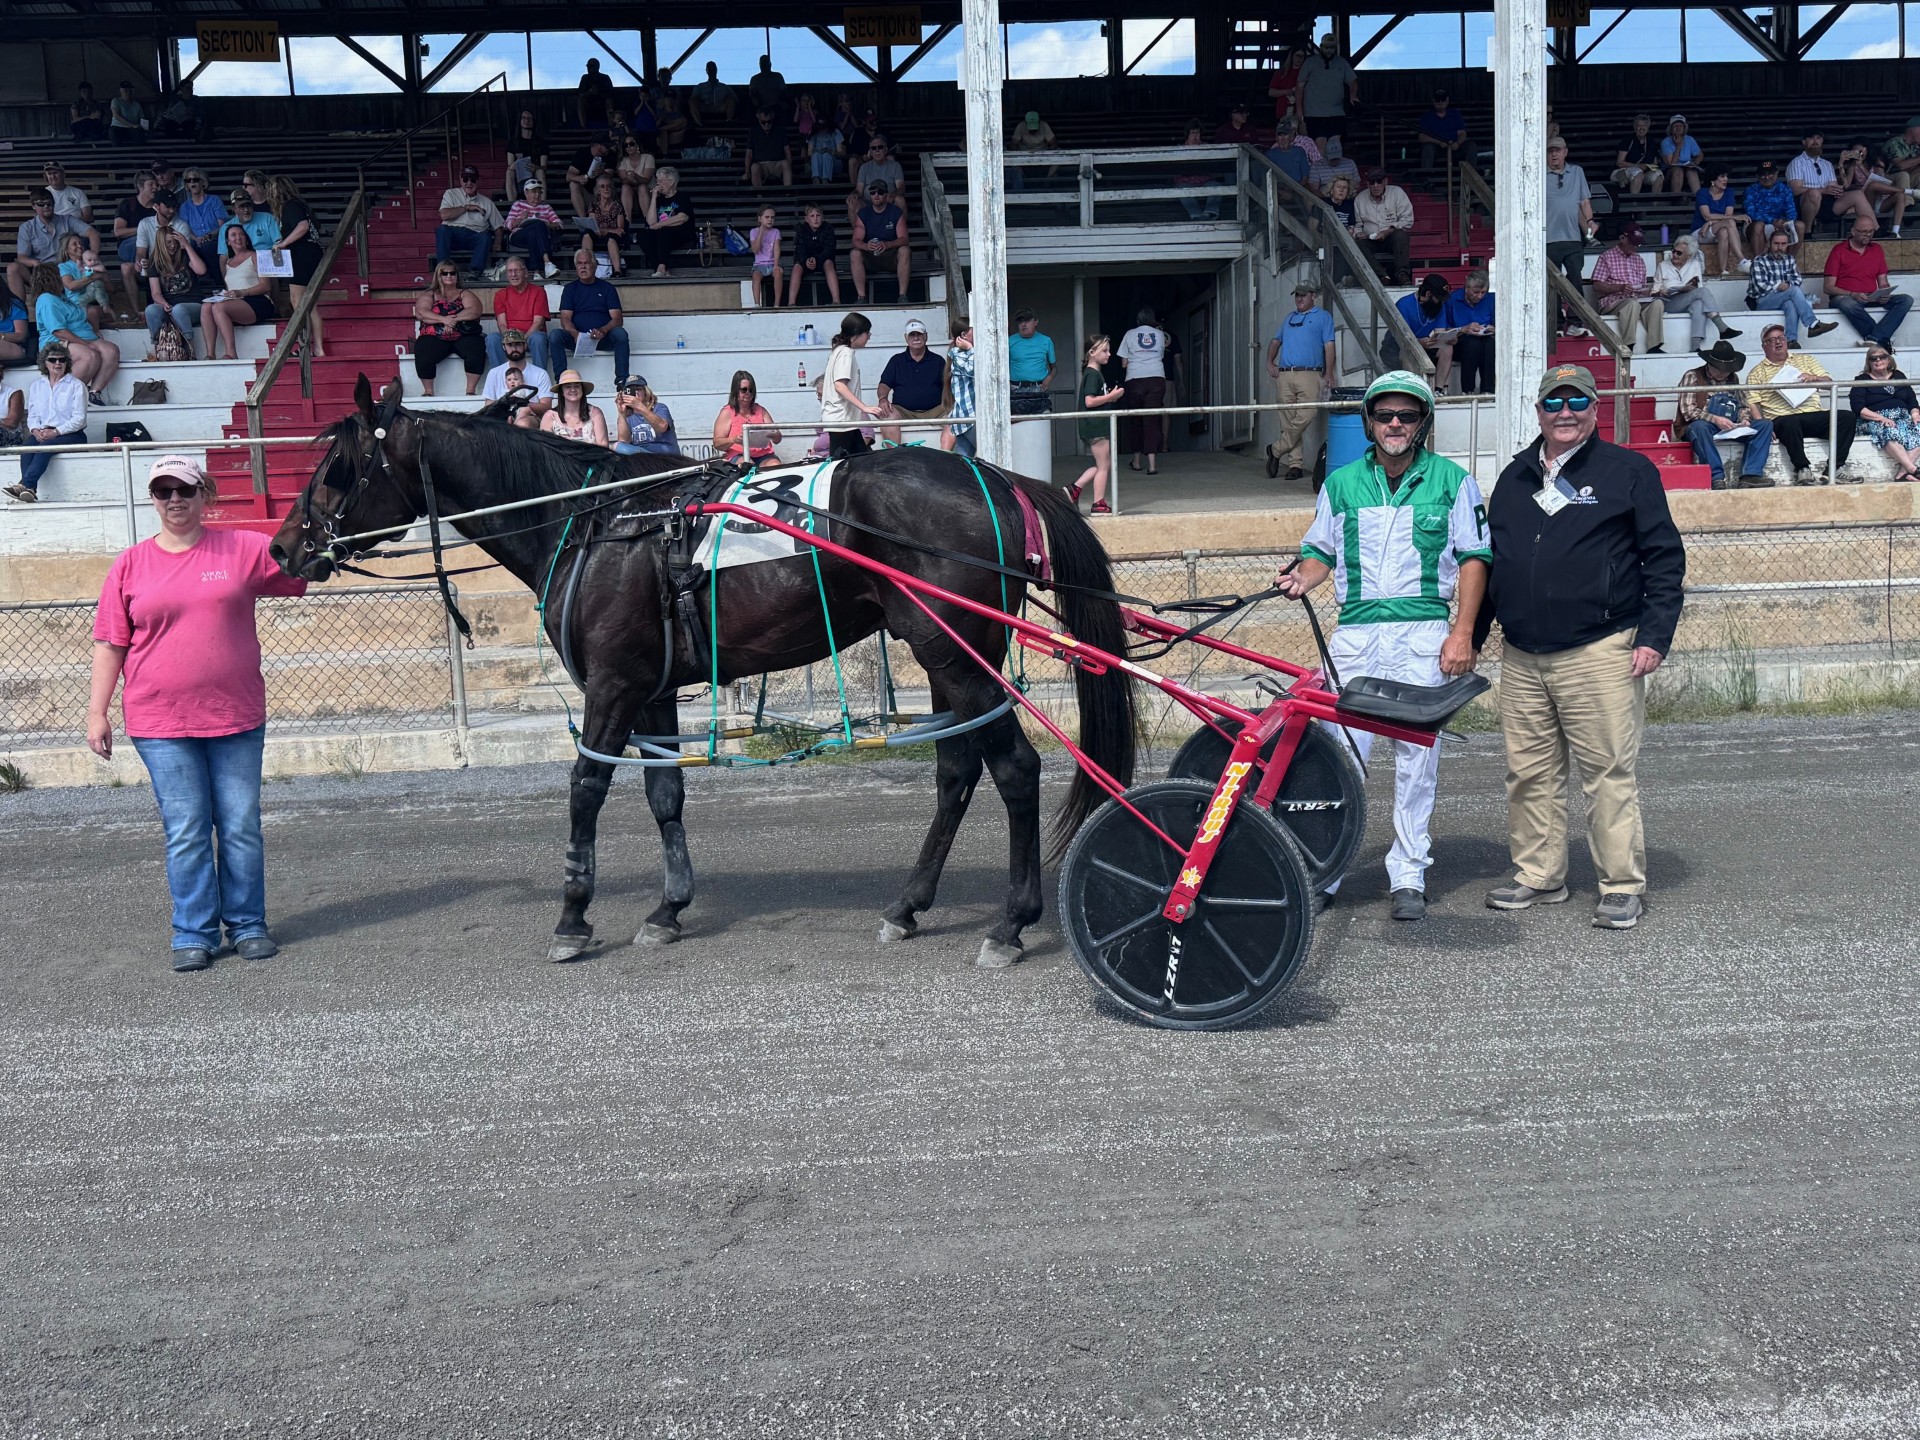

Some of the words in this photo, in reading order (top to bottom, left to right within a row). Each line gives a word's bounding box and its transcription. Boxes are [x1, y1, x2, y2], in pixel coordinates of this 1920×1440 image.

[849, 16, 906, 38] SECTION
[910, 15, 917, 37] 8
[201, 30, 265, 53] SECTION
[268, 31, 277, 53] 7
[1461, 253, 1470, 266] F
[360, 284, 369, 297] F
[1657, 429, 1670, 444] A
[1474, 504, 1487, 541] P
[1198, 762, 1252, 843] NITROUS
